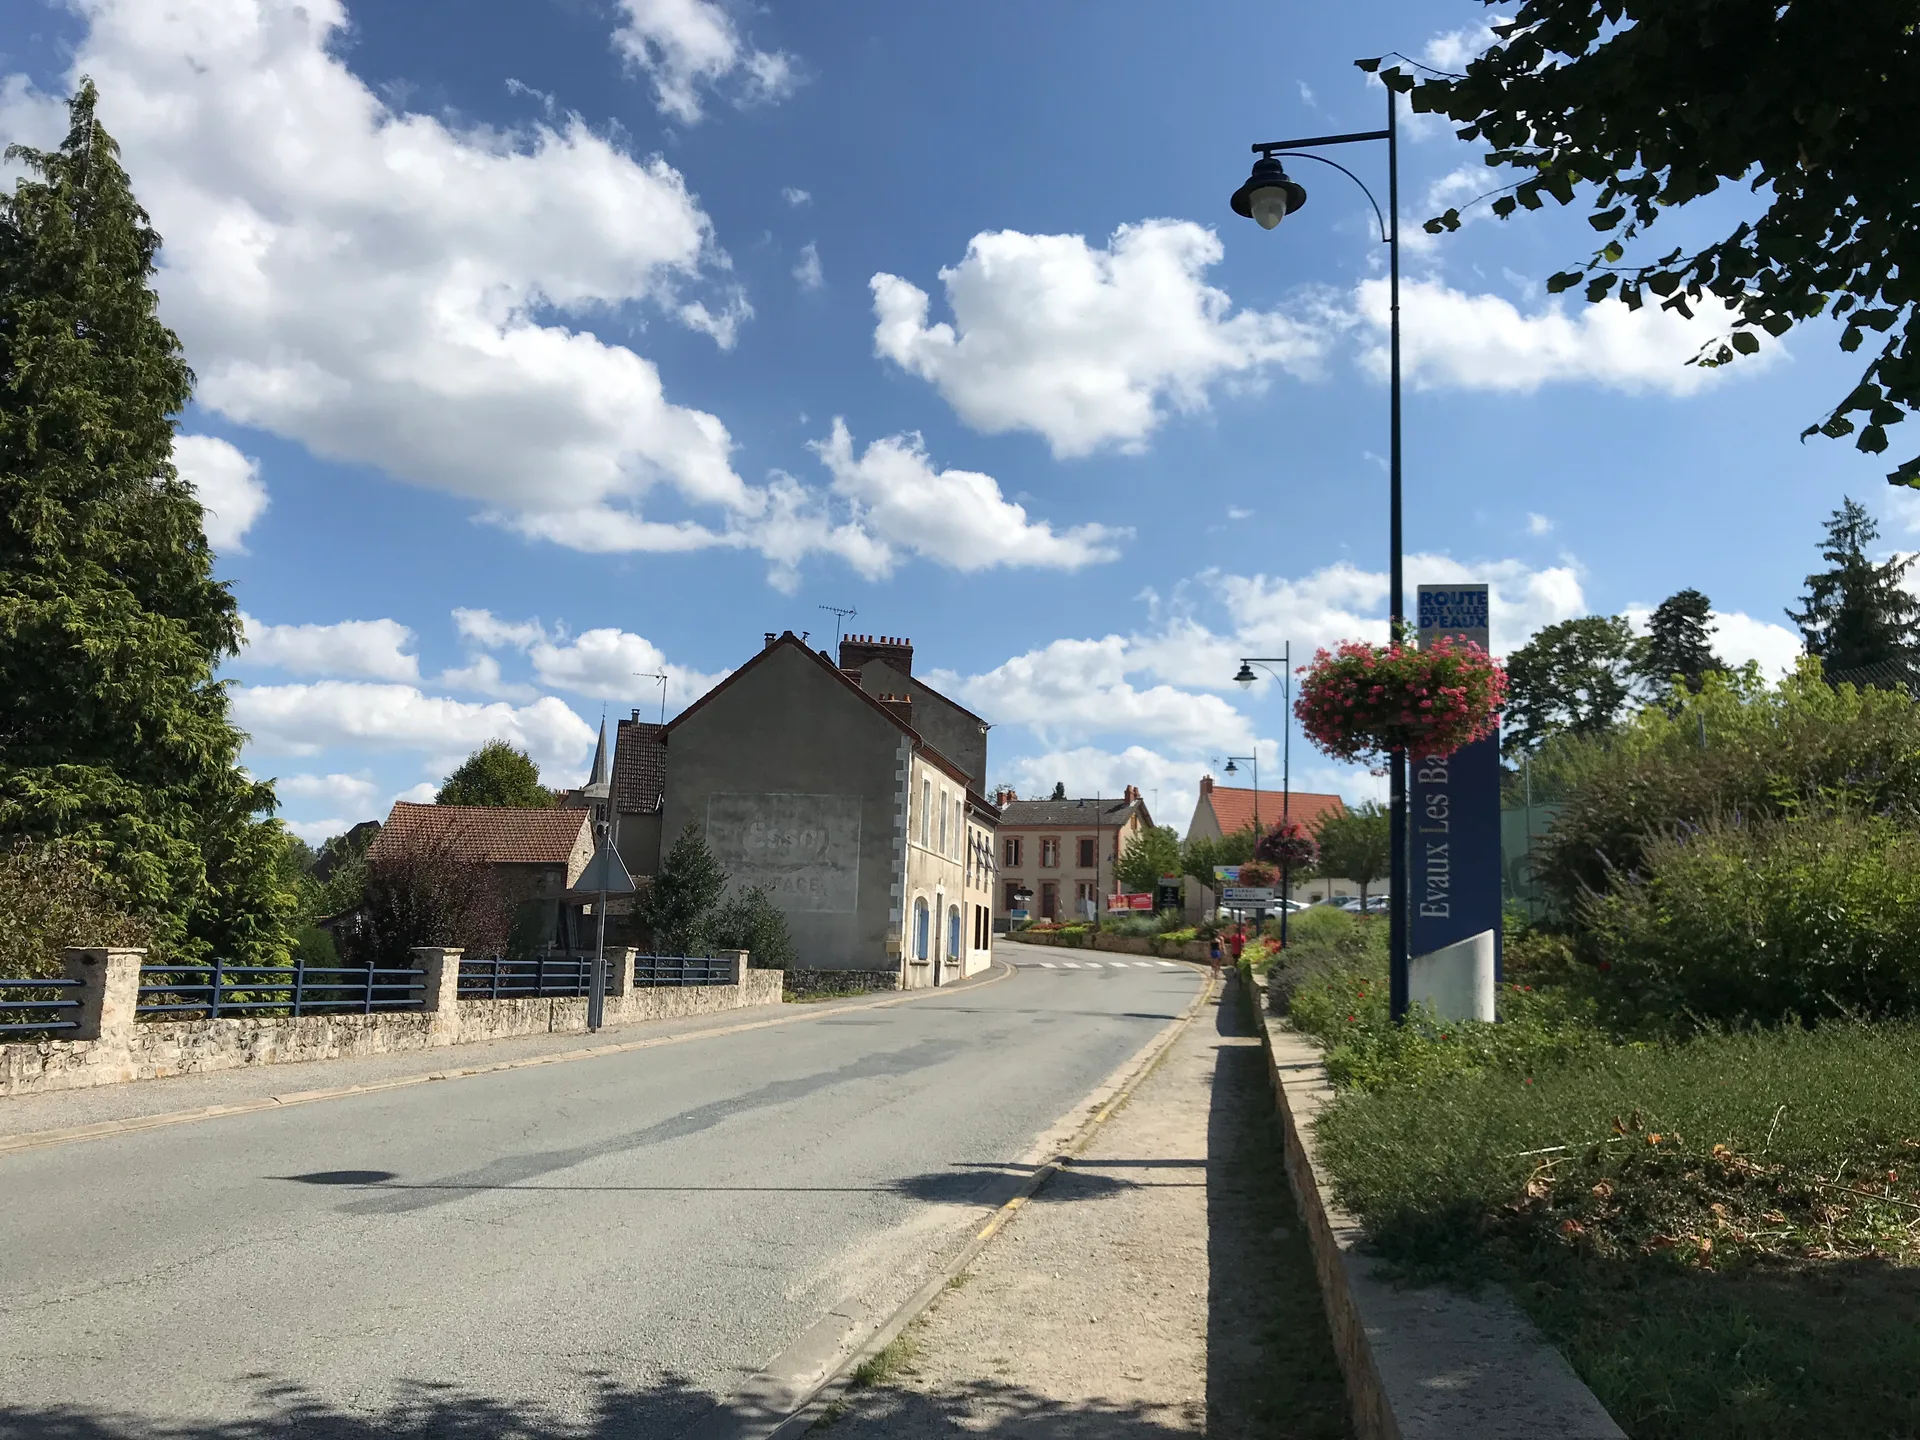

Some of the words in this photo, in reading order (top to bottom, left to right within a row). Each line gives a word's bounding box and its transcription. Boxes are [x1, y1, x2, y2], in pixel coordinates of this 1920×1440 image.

[1419, 591, 1488, 606] ROUTE
[1419, 615, 1488, 629] D'EAUX
[1420, 606, 1444, 616] DES
[1446, 606, 1488, 616] VILLES
[1417, 752, 1449, 785] Ba
[1418, 794, 1449, 834] Les
[1419, 842, 1450, 919] Evaux
